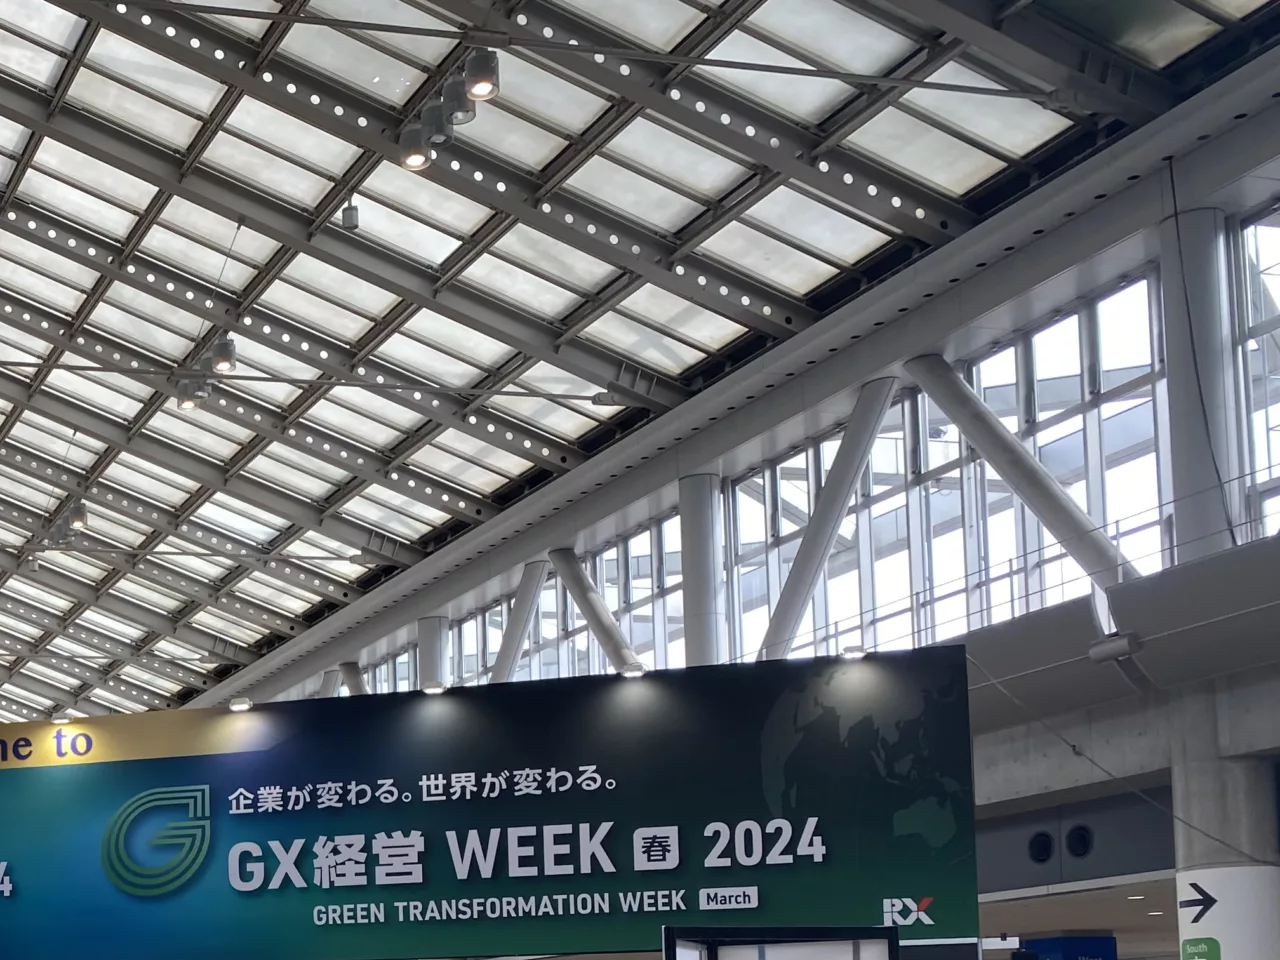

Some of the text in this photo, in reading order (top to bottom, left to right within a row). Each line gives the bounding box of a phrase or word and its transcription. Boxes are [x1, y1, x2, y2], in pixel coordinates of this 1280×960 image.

[52, 728, 93, 758] to
[228, 764, 616, 815] 企業が変わる。世界が変わる。
[228, 816, 827, 892] GX経営 WEEK 春 2024
[313, 889, 752, 926] GREEN TRANSFORMATION WEEK March
[883, 896, 935, 926] RX
[1186, 944, 1208, 953] South
